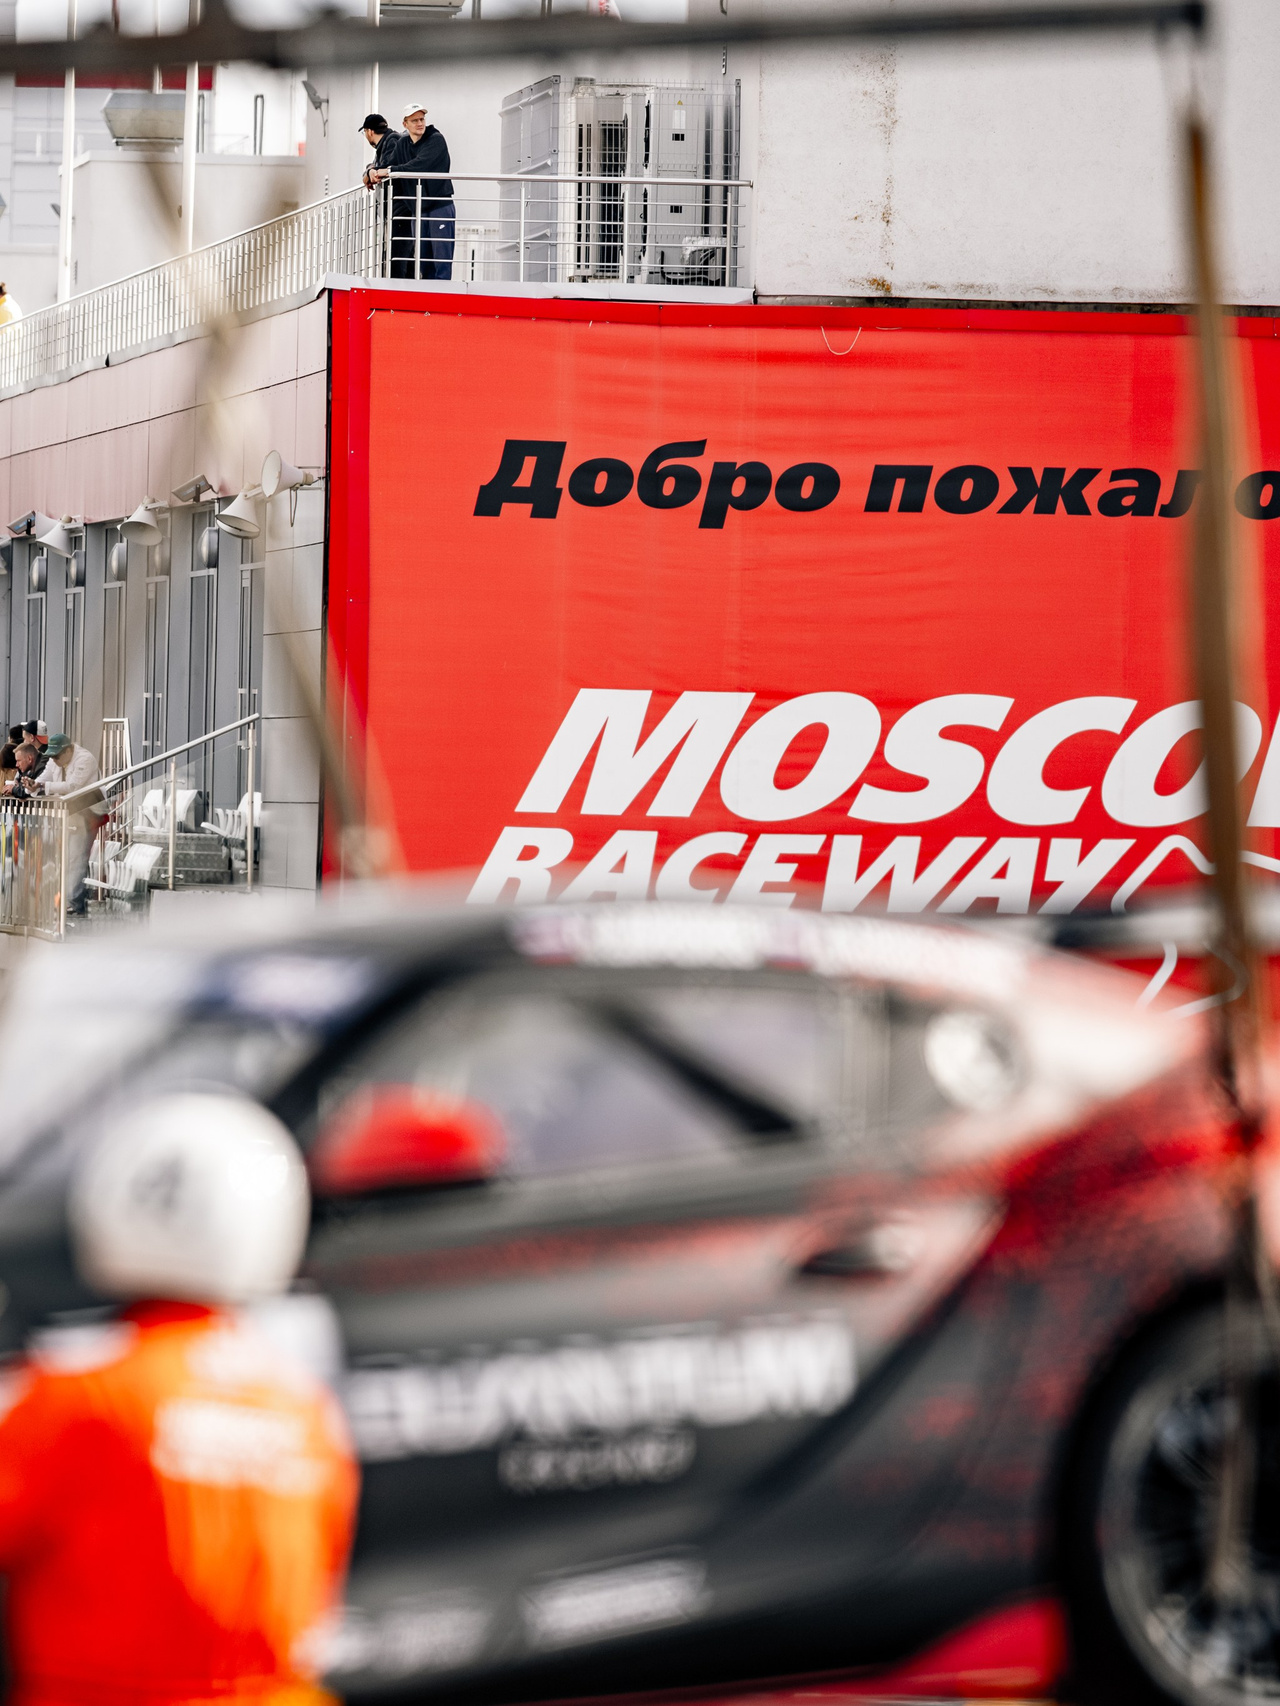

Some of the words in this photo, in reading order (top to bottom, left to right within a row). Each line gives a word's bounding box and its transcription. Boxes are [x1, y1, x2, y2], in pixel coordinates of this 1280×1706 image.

[473, 438, 841, 529] Добро
[865, 463, 1280, 520] пожало
[514, 688, 1280, 829] MOSCO
[466, 826, 1136, 914] RACEWAY
